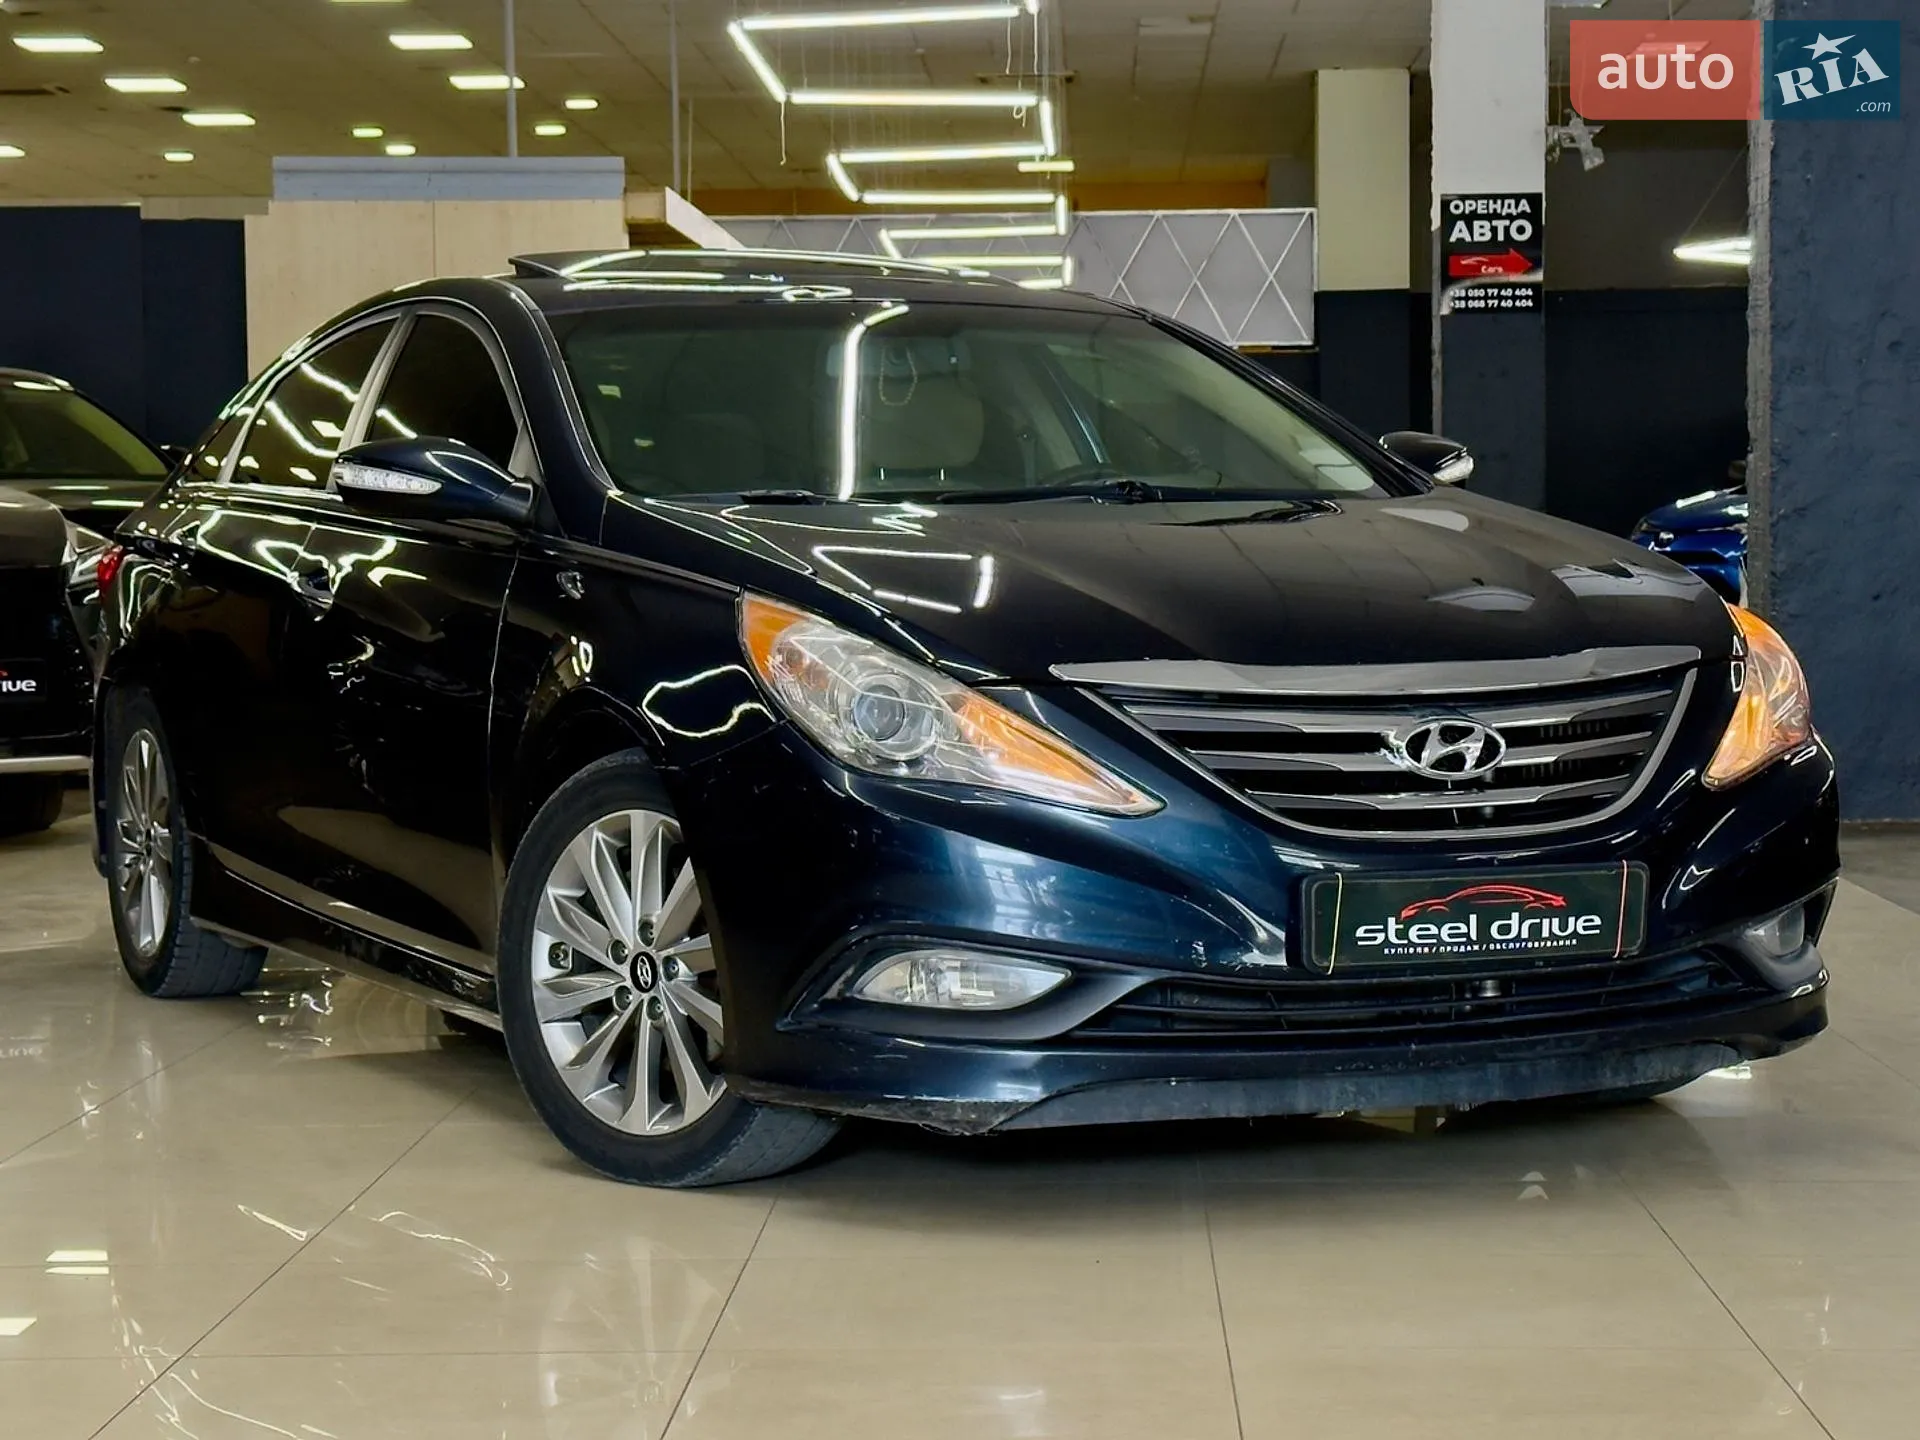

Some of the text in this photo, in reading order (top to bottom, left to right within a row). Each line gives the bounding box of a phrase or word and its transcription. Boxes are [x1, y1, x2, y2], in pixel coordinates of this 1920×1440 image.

[1449, 198, 1531, 216] ОРЕНДА
[1449, 219, 1533, 242] АВТО
[1487, 288, 1499, 297] 77
[1500, 287, 1513, 297] 40
[1514, 287, 1533, 296] 404
[1487, 299, 1499, 308] 77
[1500, 299, 1513, 307] 40
[1514, 298, 1533, 307] 404
[1355, 912, 1602, 946] steel drive
